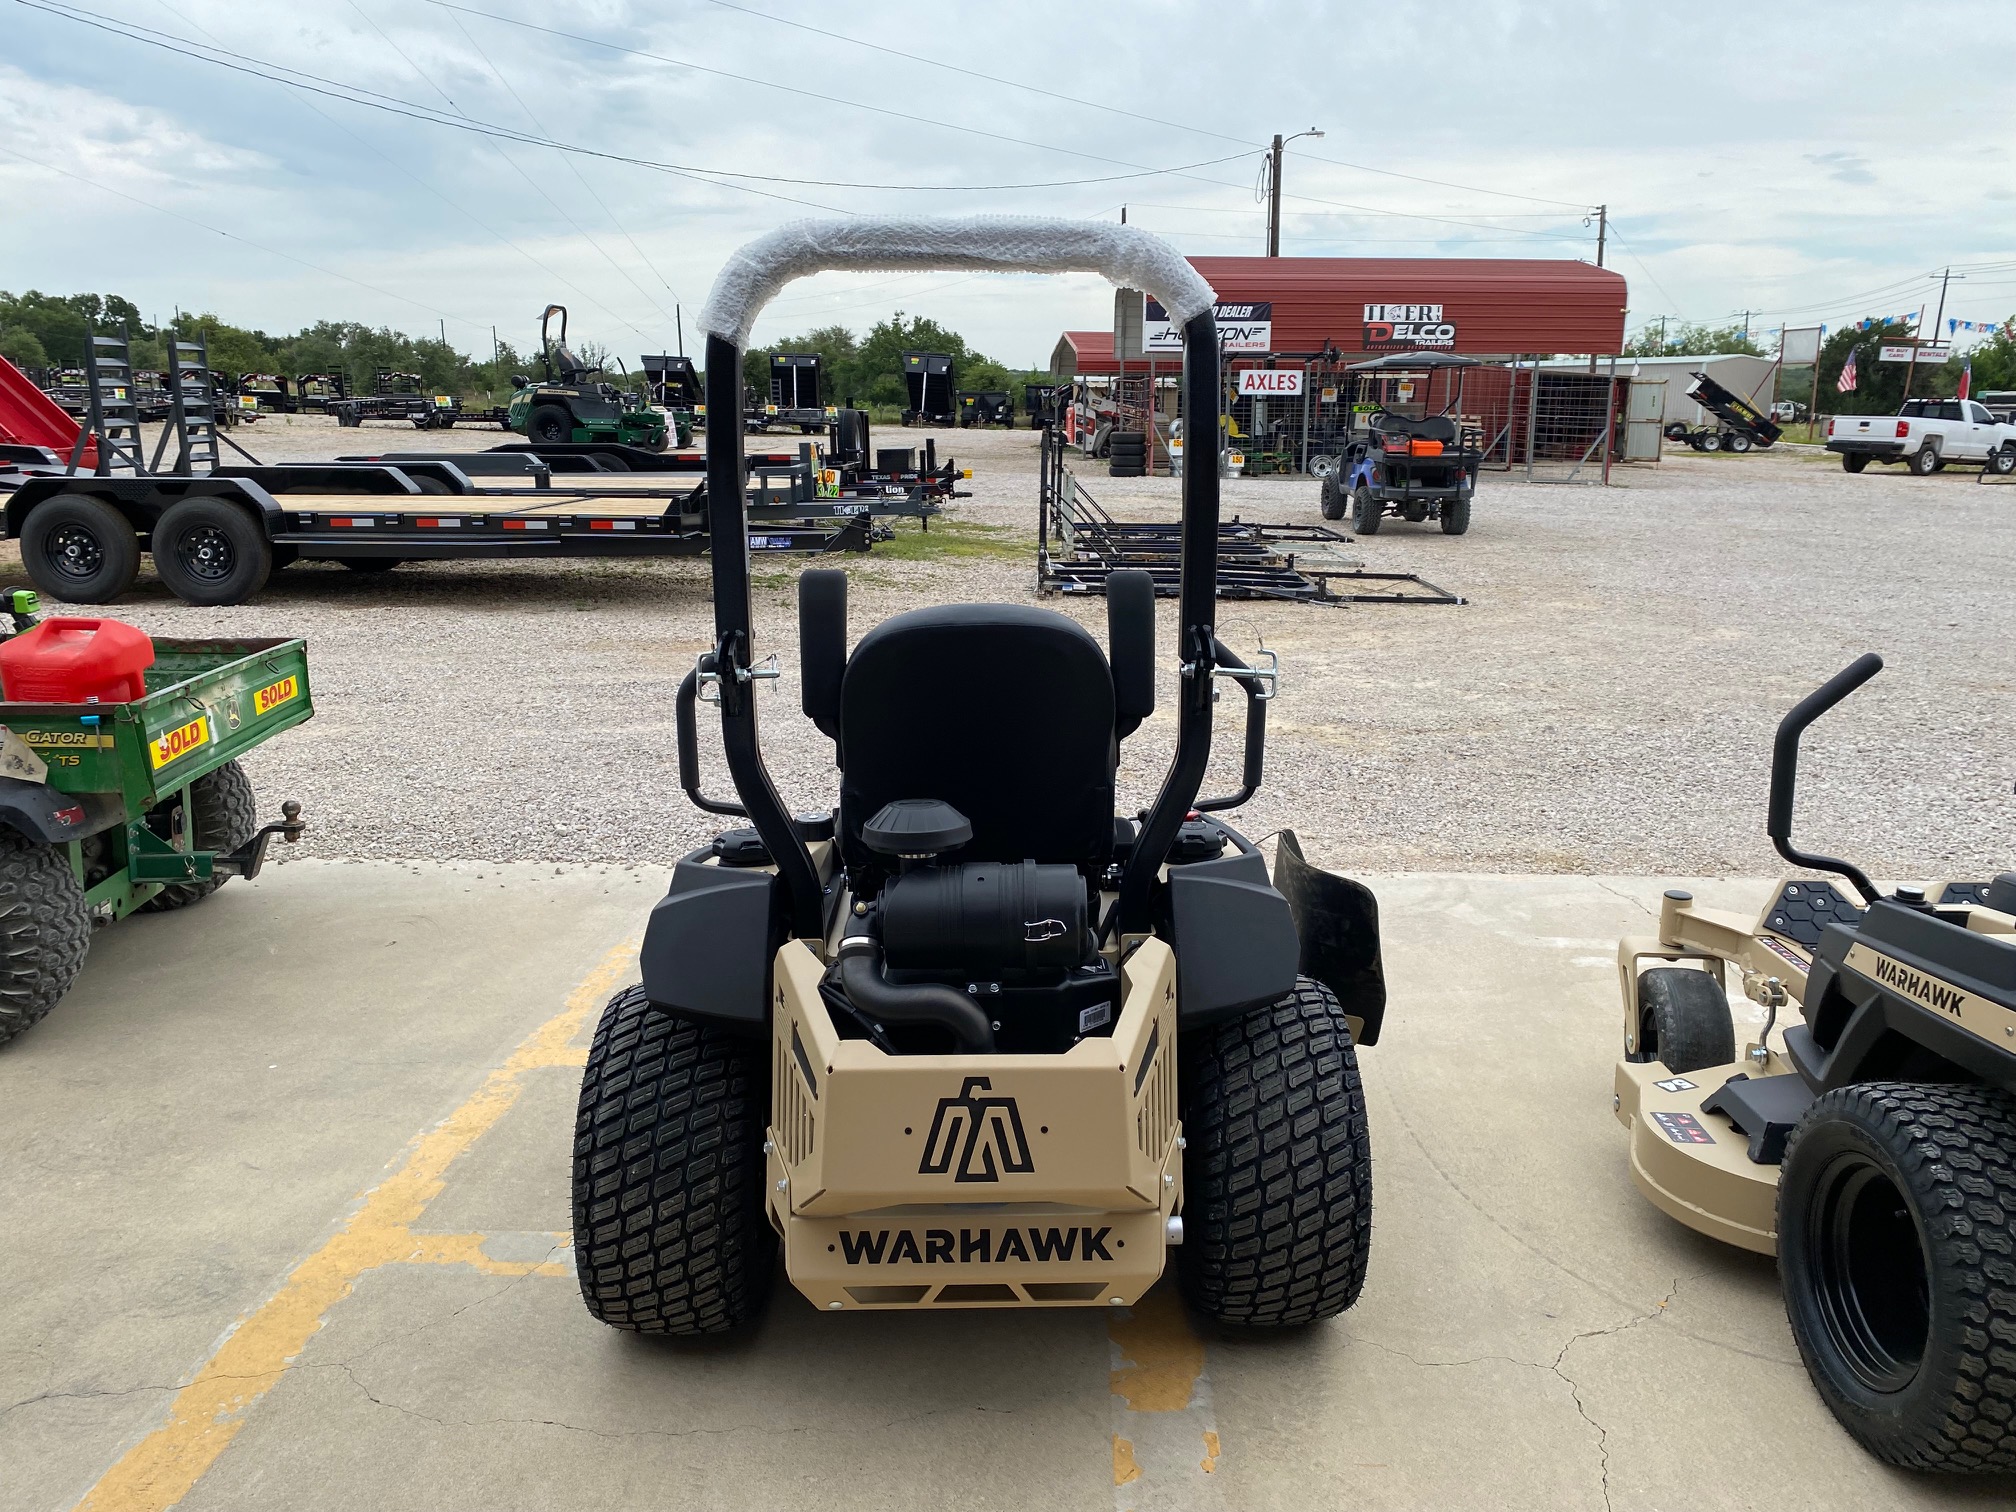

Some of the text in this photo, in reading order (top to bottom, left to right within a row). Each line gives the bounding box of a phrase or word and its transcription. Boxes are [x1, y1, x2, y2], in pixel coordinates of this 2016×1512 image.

[1218, 305, 1253, 318] DEALER
[1366, 322, 1455, 342] DELCO
[1244, 373, 1298, 391] AXLES
[885, 485, 905, 494] lion
[261, 679, 292, 709] SOLD
[25, 730, 86, 743] GATOR
[159, 722, 200, 762] SOLD
[1876, 956, 1966, 1018] WARHAWK
[838, 1226, 1115, 1265] WARHAWK
